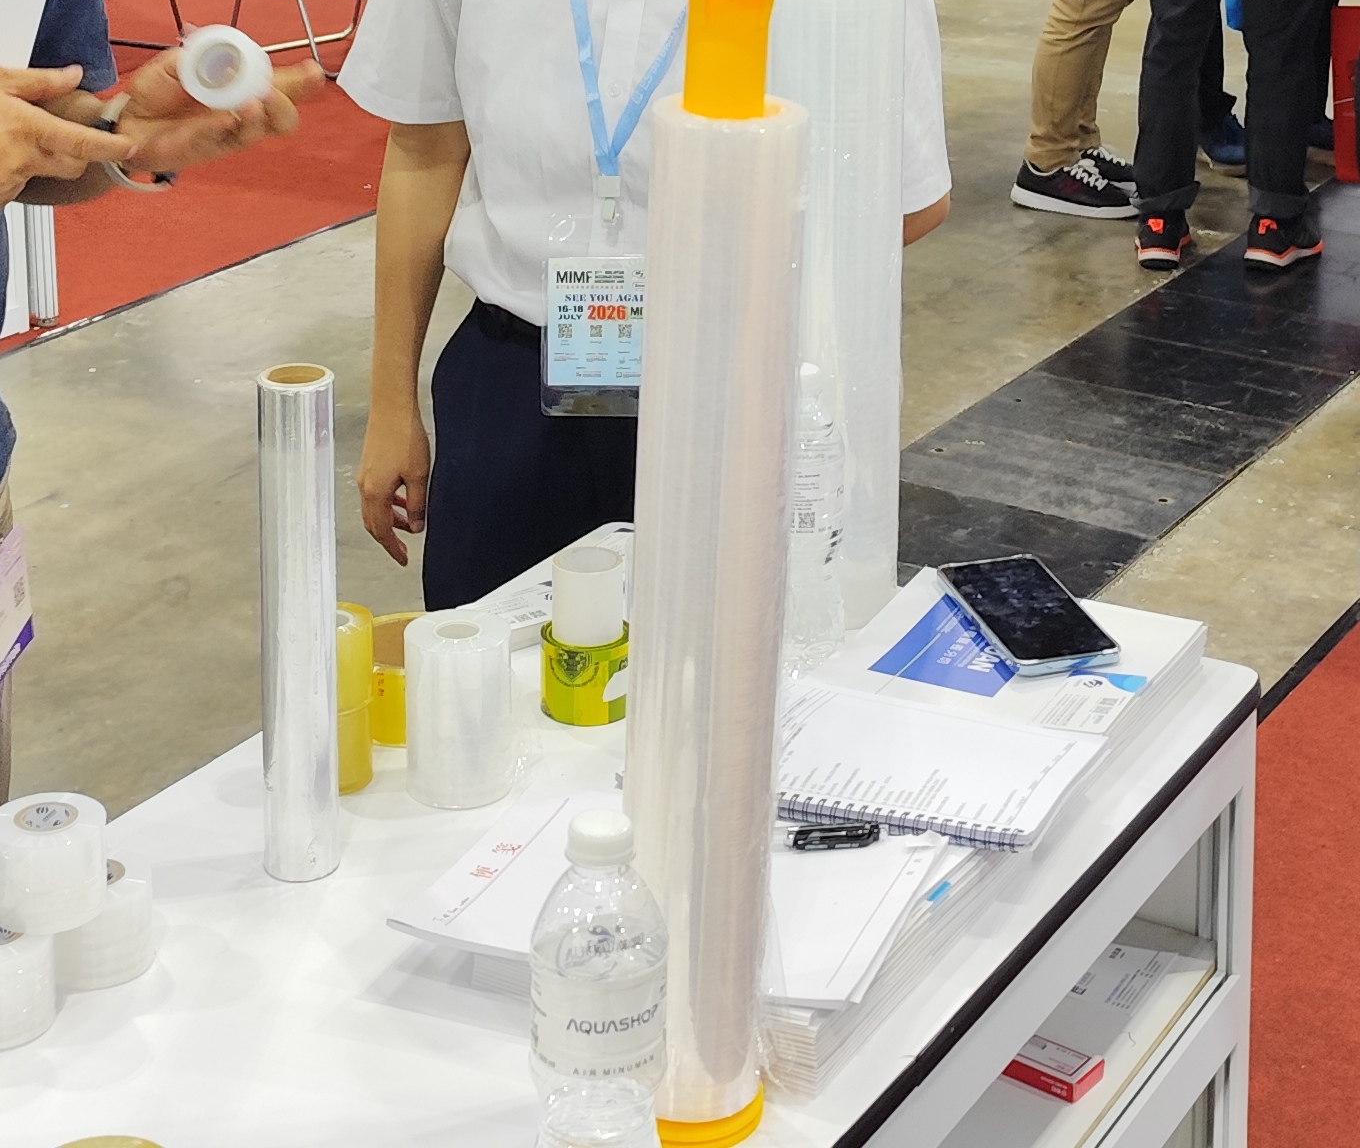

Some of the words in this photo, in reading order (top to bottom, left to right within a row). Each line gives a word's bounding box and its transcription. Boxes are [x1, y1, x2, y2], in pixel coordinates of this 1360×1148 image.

[556, 271, 593, 283] MIMF
[565, 294, 586, 302] SEE
[589, 294, 613, 302] YOU
[616, 294, 644, 302] AGAI
[557, 305, 584, 313] 16-18
[587, 305, 627, 321] 2026
